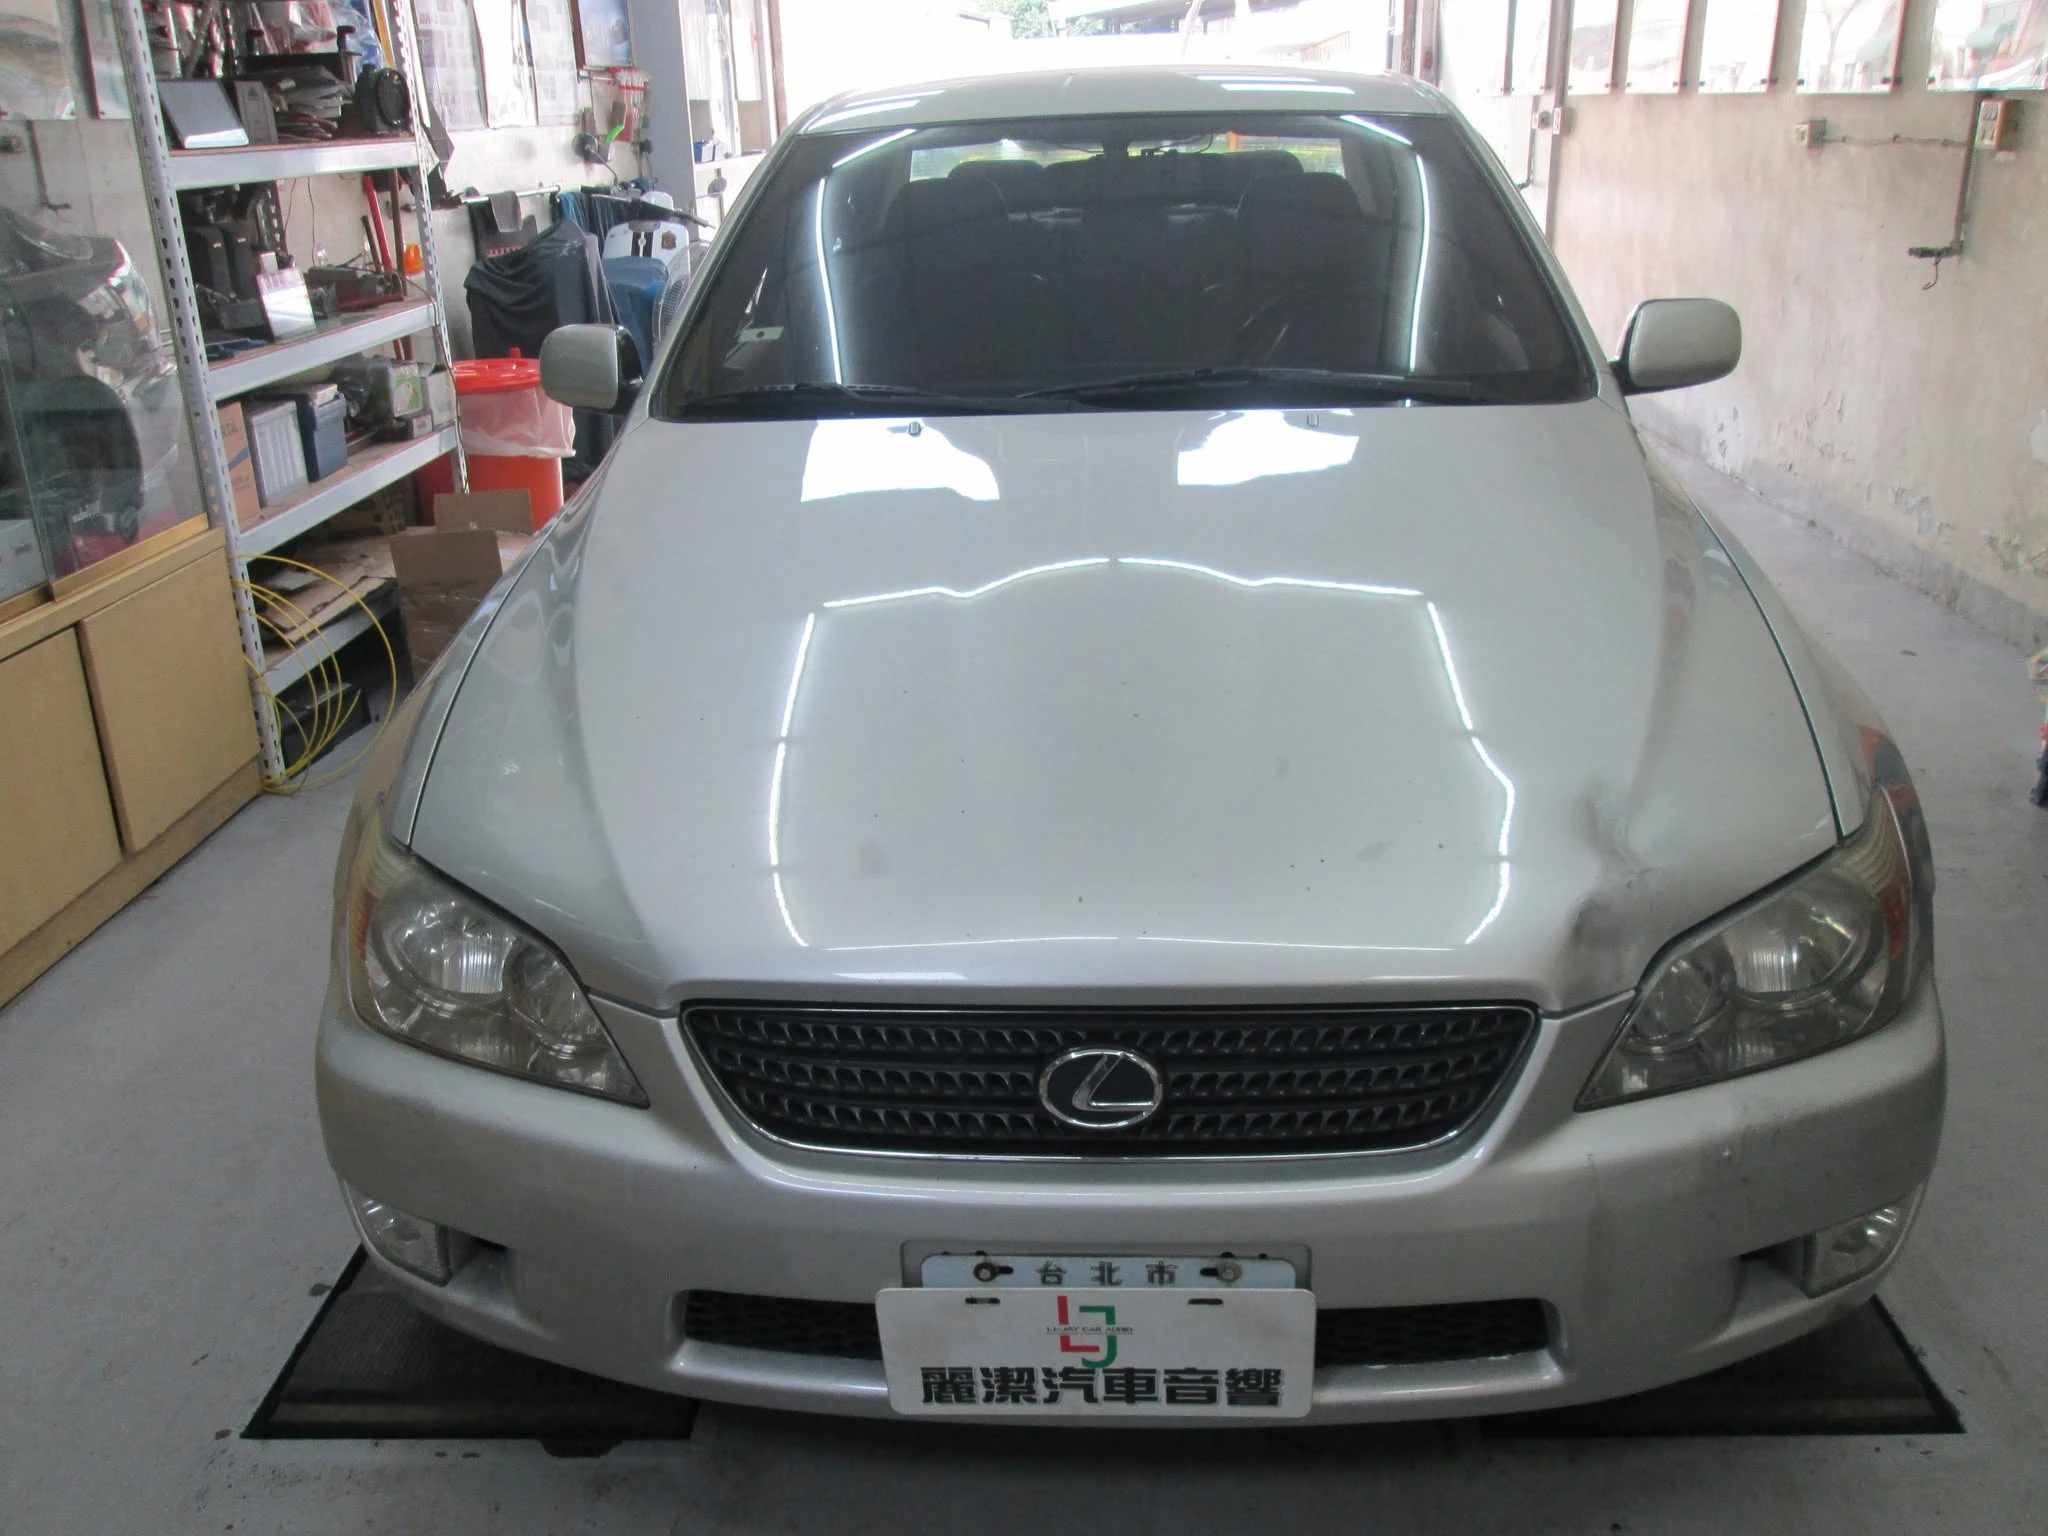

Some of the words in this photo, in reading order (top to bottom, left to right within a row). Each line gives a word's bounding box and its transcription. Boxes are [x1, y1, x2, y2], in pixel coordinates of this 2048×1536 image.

[1036, 1260, 1179, 1286] 台北市
[920, 1366, 1282, 1405] 麗潔汽車音響
